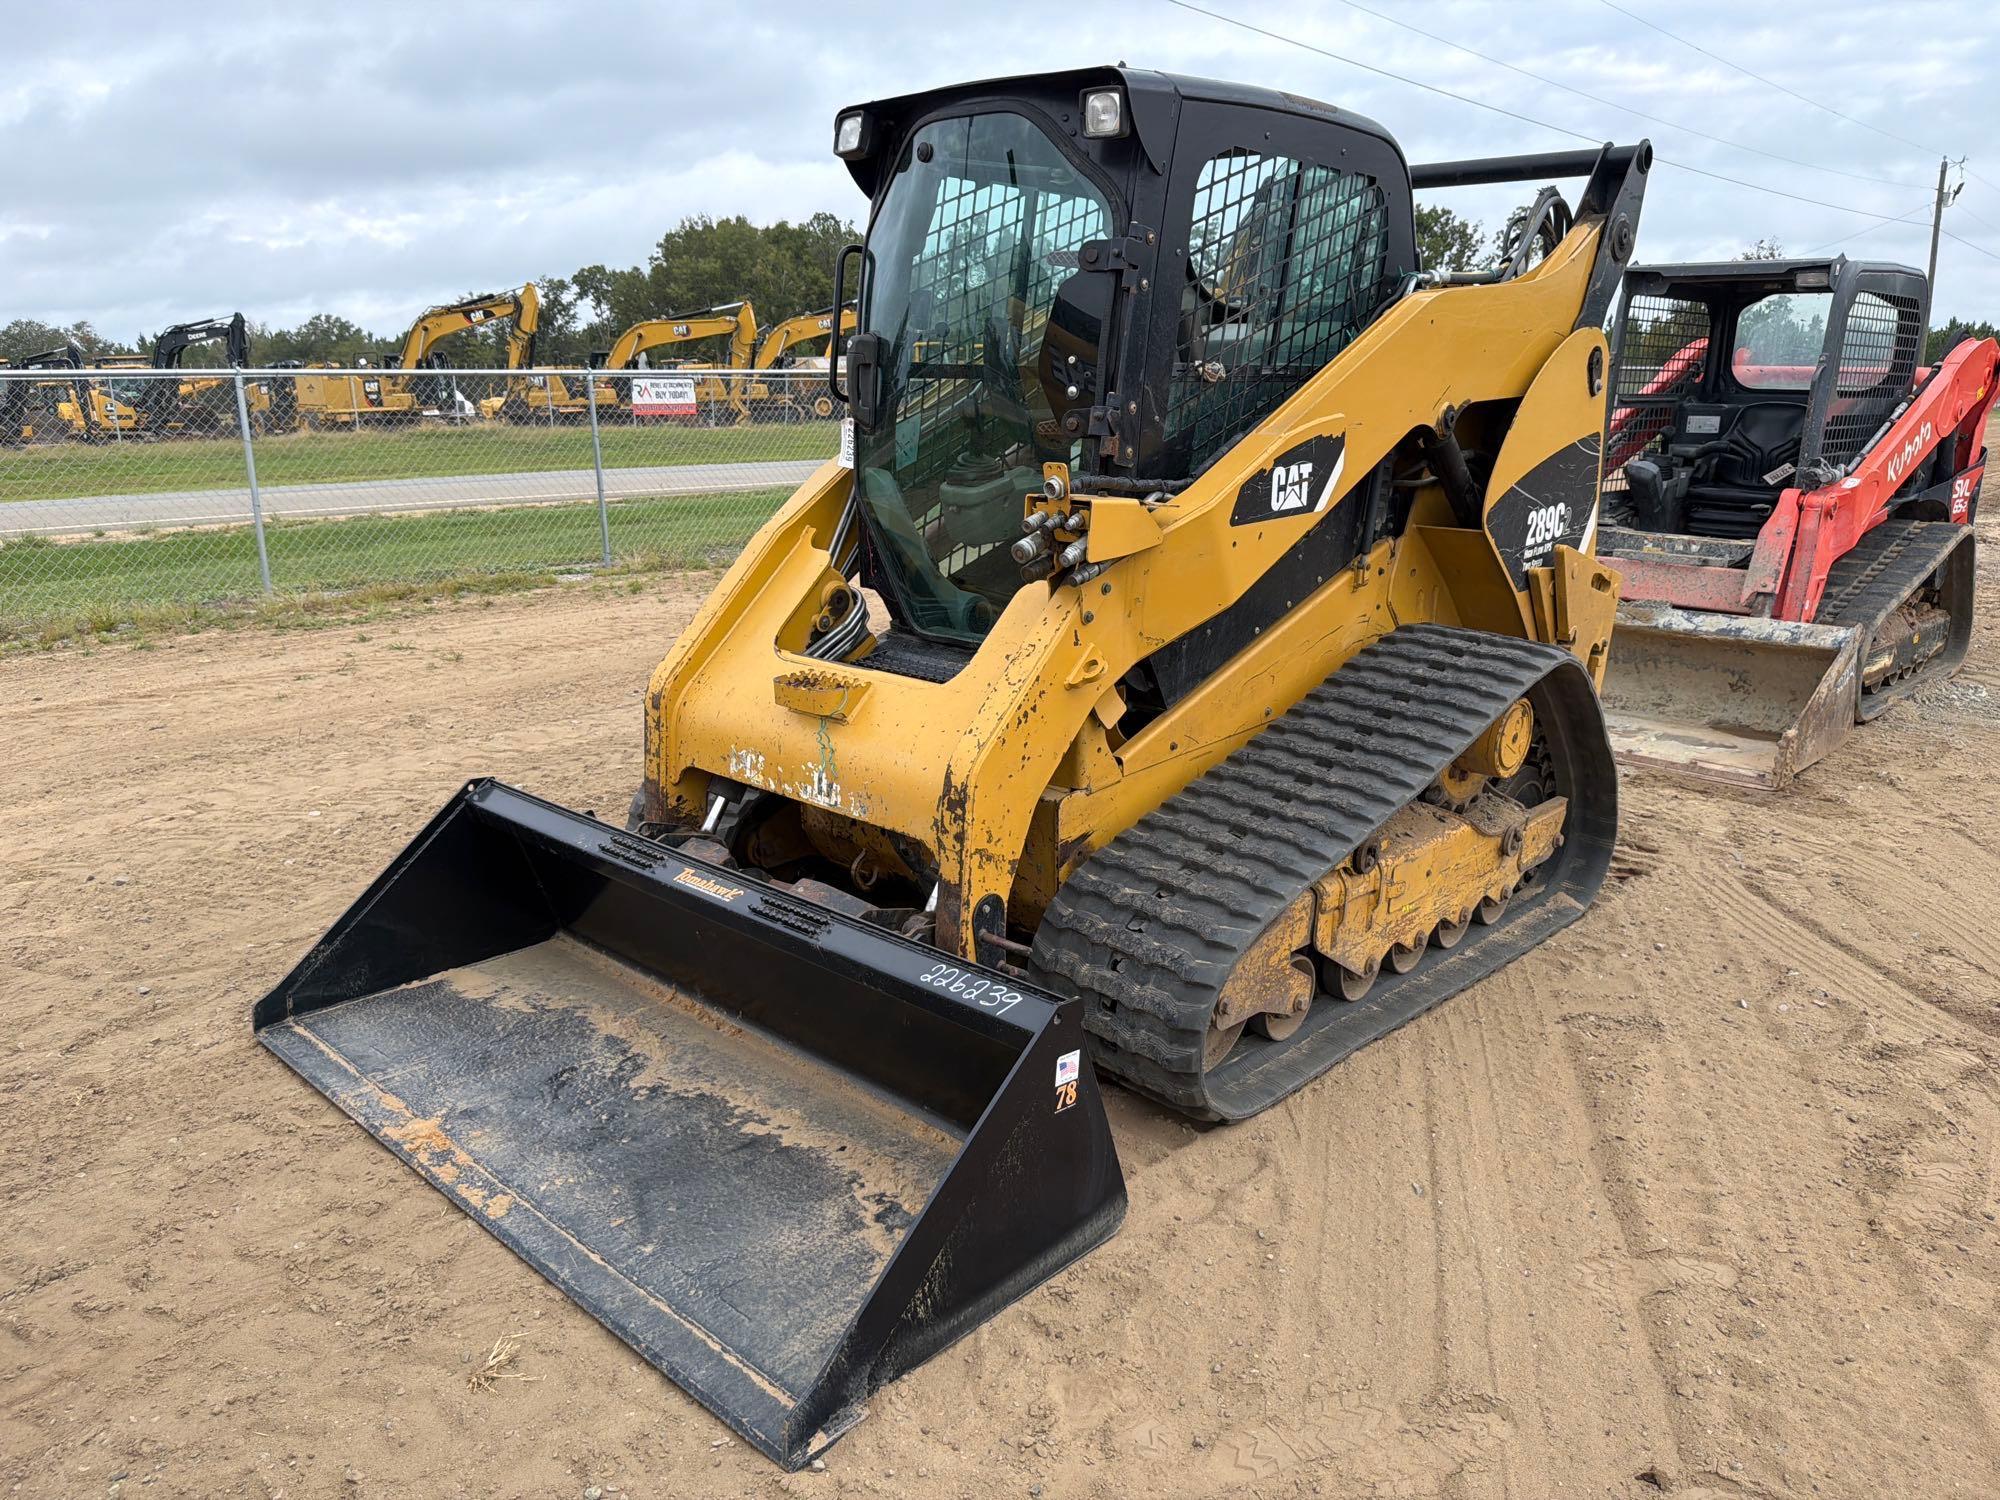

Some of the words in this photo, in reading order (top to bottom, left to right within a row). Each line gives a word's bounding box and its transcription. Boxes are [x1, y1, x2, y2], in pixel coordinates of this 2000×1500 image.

[471, 309, 485, 322] CAT
[818, 319, 832, 330] CAT
[187, 331, 208, 340] DEERE
[673, 325, 688, 336] CAT
[655, 391, 667, 399] BUY
[846, 428, 855, 462] 226239
[1887, 421, 1931, 482] Kubota
[1271, 462, 1313, 511] CAT
[1952, 478, 1970, 498] SVL
[673, 867, 744, 900] Tomahawk
[920, 964, 1023, 1016] 226239
[1056, 1080, 1077, 1110] 78
